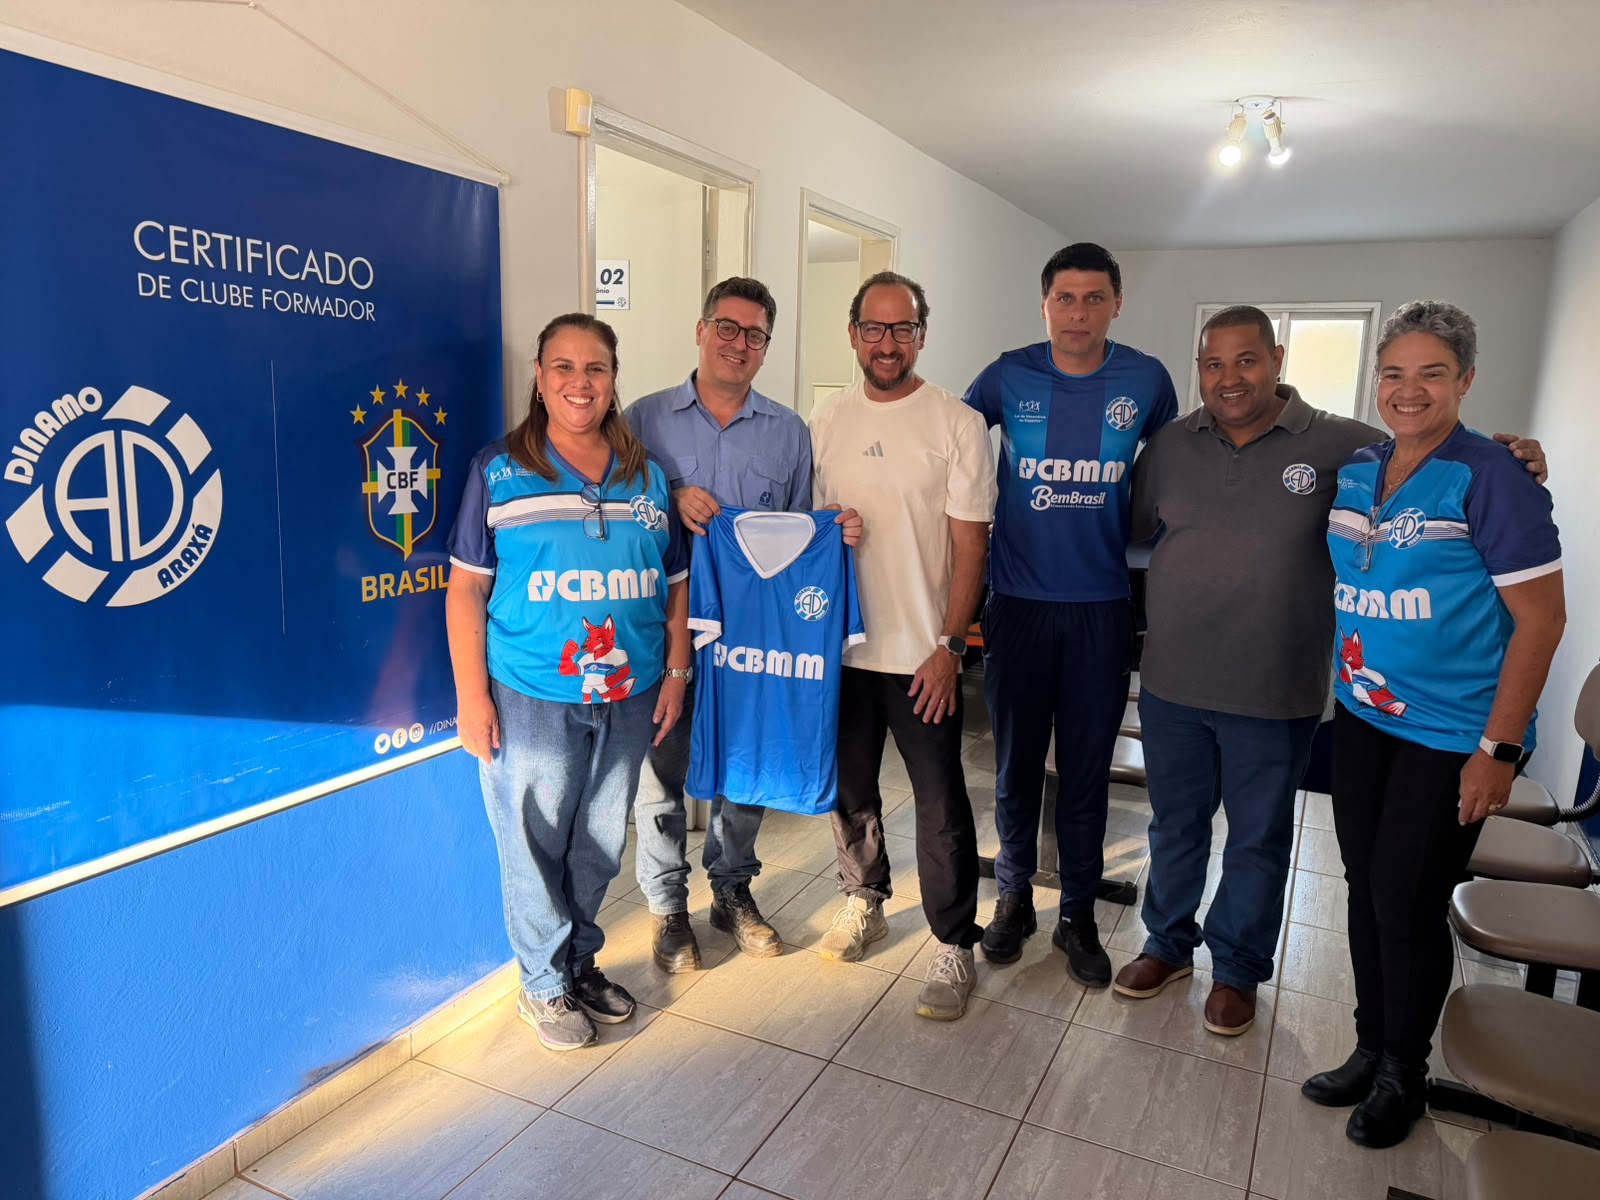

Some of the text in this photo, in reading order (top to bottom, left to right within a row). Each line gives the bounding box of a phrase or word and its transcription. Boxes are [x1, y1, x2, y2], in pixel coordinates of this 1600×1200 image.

[133, 220, 374, 290] CERTIFICADO
[600, 268, 624, 285] 02
[138, 272, 376, 321] DE CLUBE FORMADOR
[4, 386, 103, 485] DINAMO
[387, 471, 418, 490] CBF
[1037, 458, 1126, 483] CBMM
[1030, 485, 1106, 511] BemBrasil
[157, 523, 214, 589] ARAXÁ
[361, 565, 449, 602] BRASIL
[727, 646, 825, 680] CBMM
